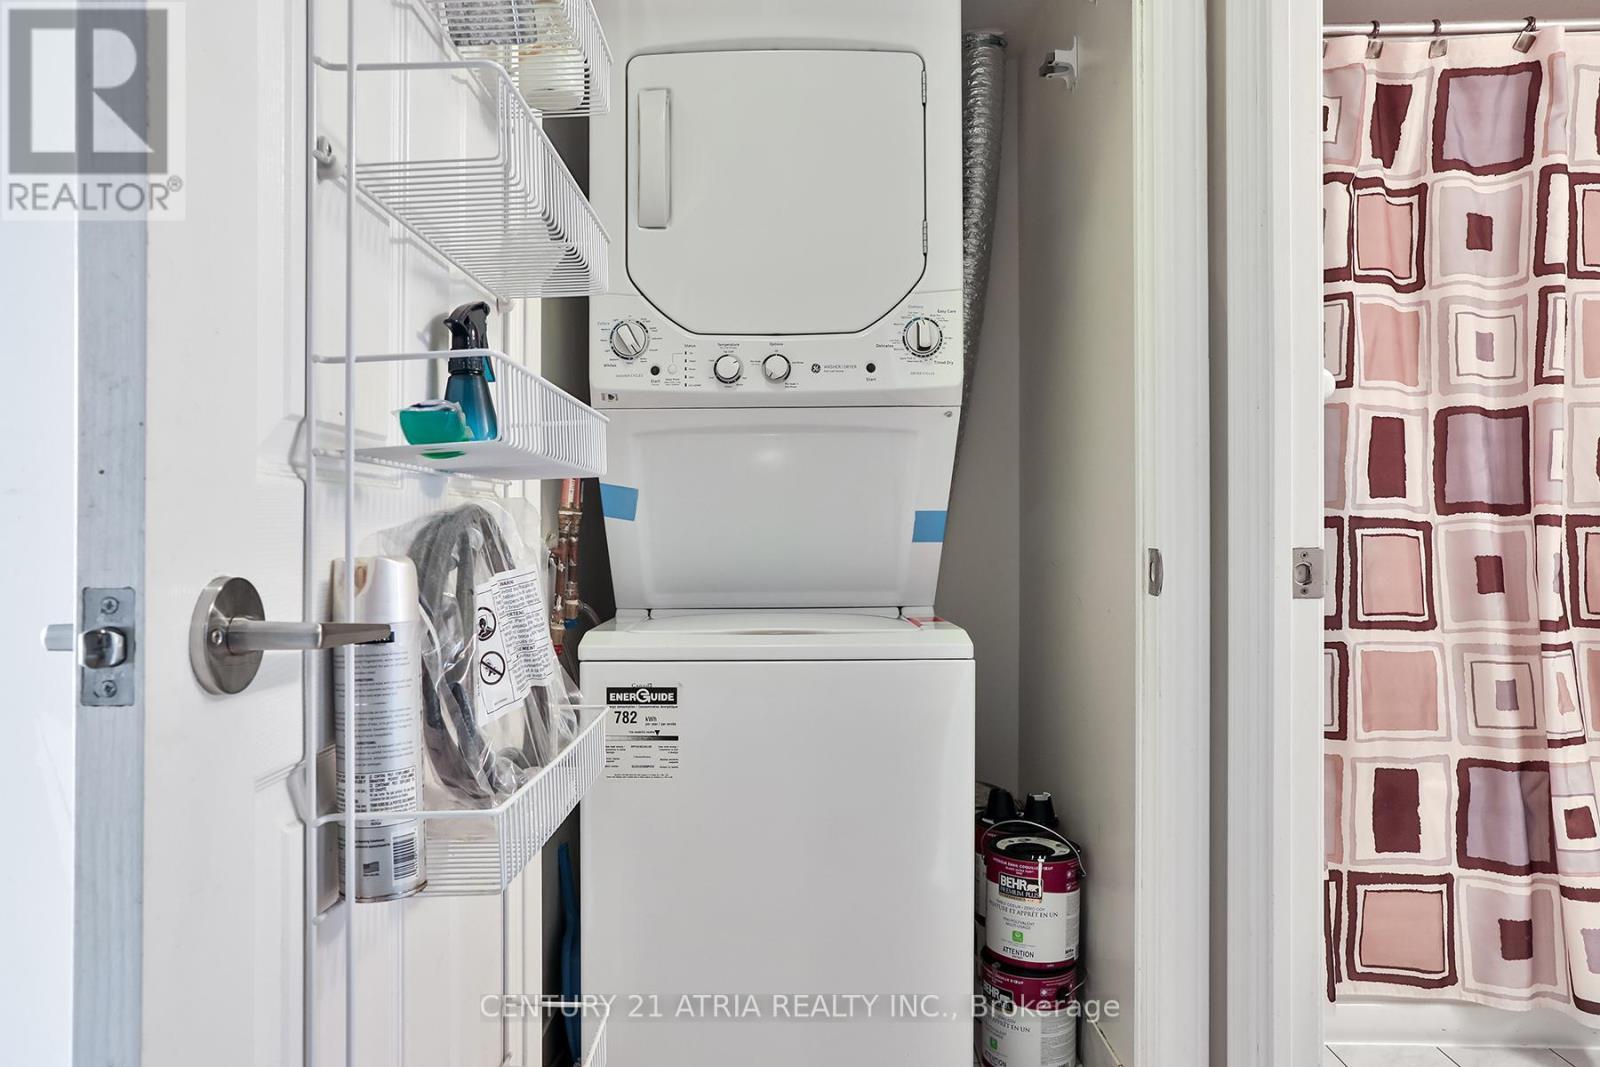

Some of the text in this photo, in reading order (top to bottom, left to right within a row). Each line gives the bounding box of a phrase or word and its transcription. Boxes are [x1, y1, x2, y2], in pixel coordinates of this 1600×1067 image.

[609, 688, 675, 703] ENERGUIDE
[614, 711, 638, 724] 782
[1000, 875, 1027, 891] BEHR
[1009, 907, 1016, 915] ET
[1003, 946, 1035, 958] ATTENTION
